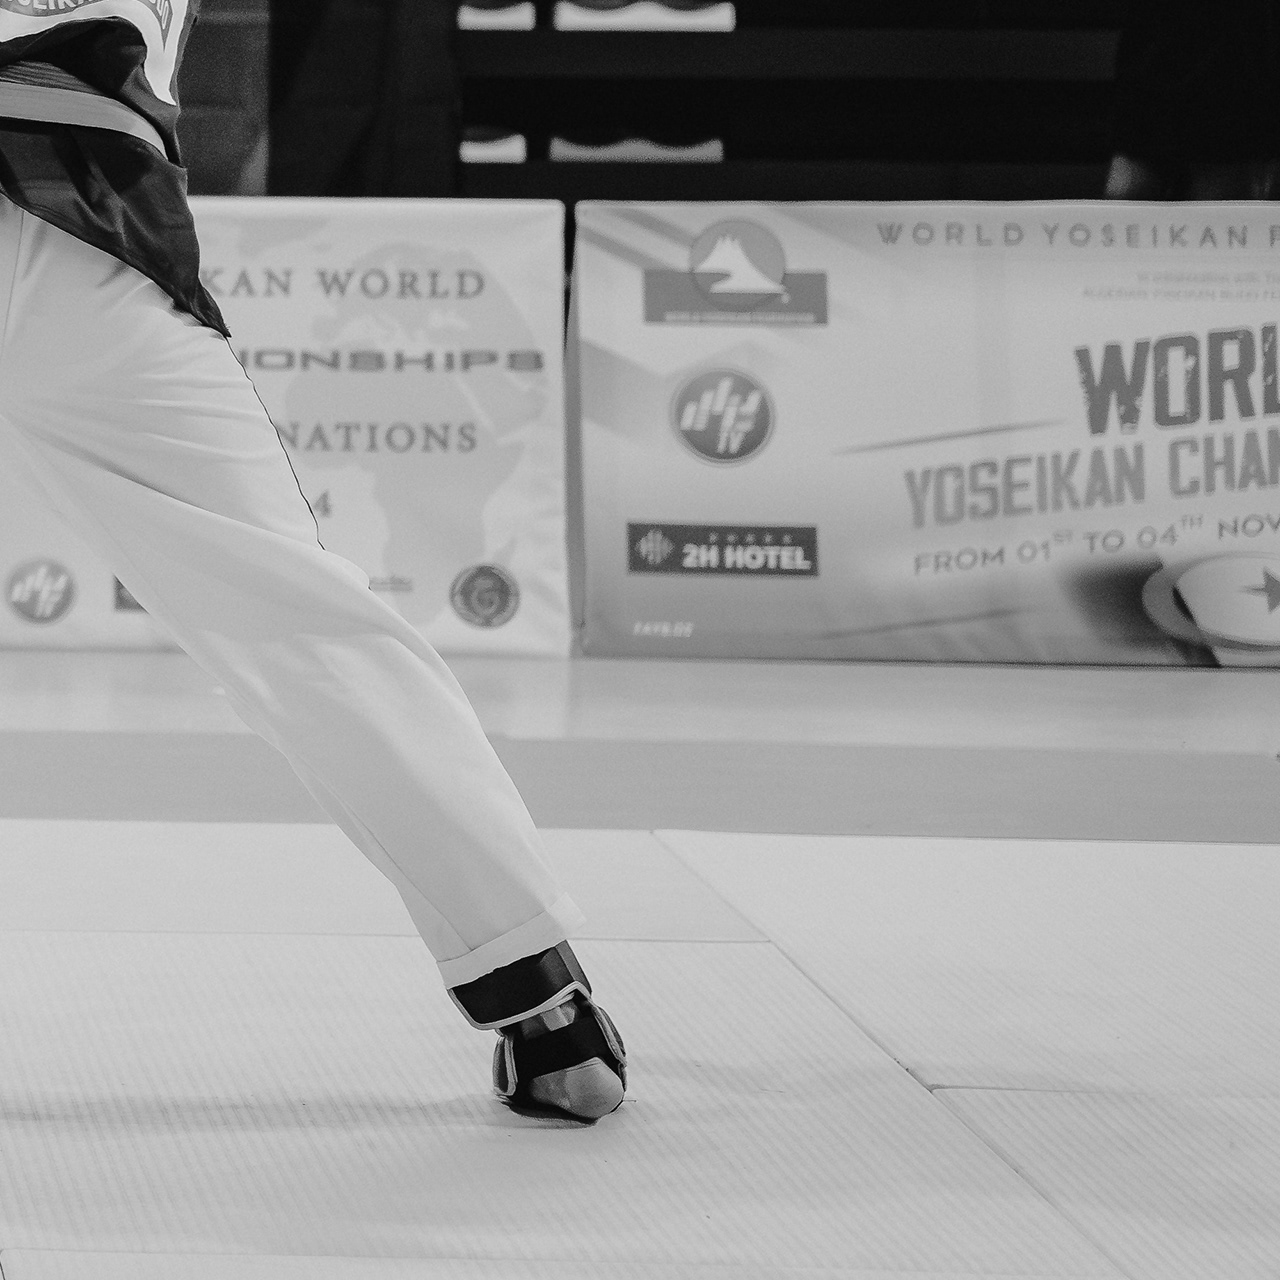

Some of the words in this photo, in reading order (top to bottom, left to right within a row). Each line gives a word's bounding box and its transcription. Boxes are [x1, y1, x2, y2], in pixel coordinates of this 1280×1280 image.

[876, 221, 1025, 247] WORLD
[1042, 223, 1249, 249] YOSEIKAN
[316, 268, 486, 299] WORLD
[903, 447, 1147, 529] YOSEIKAN
[682, 543, 720, 569] 2H
[723, 545, 813, 571] HOTEL
[913, 545, 1007, 576] FROM
[1083, 528, 1125, 554] TO
